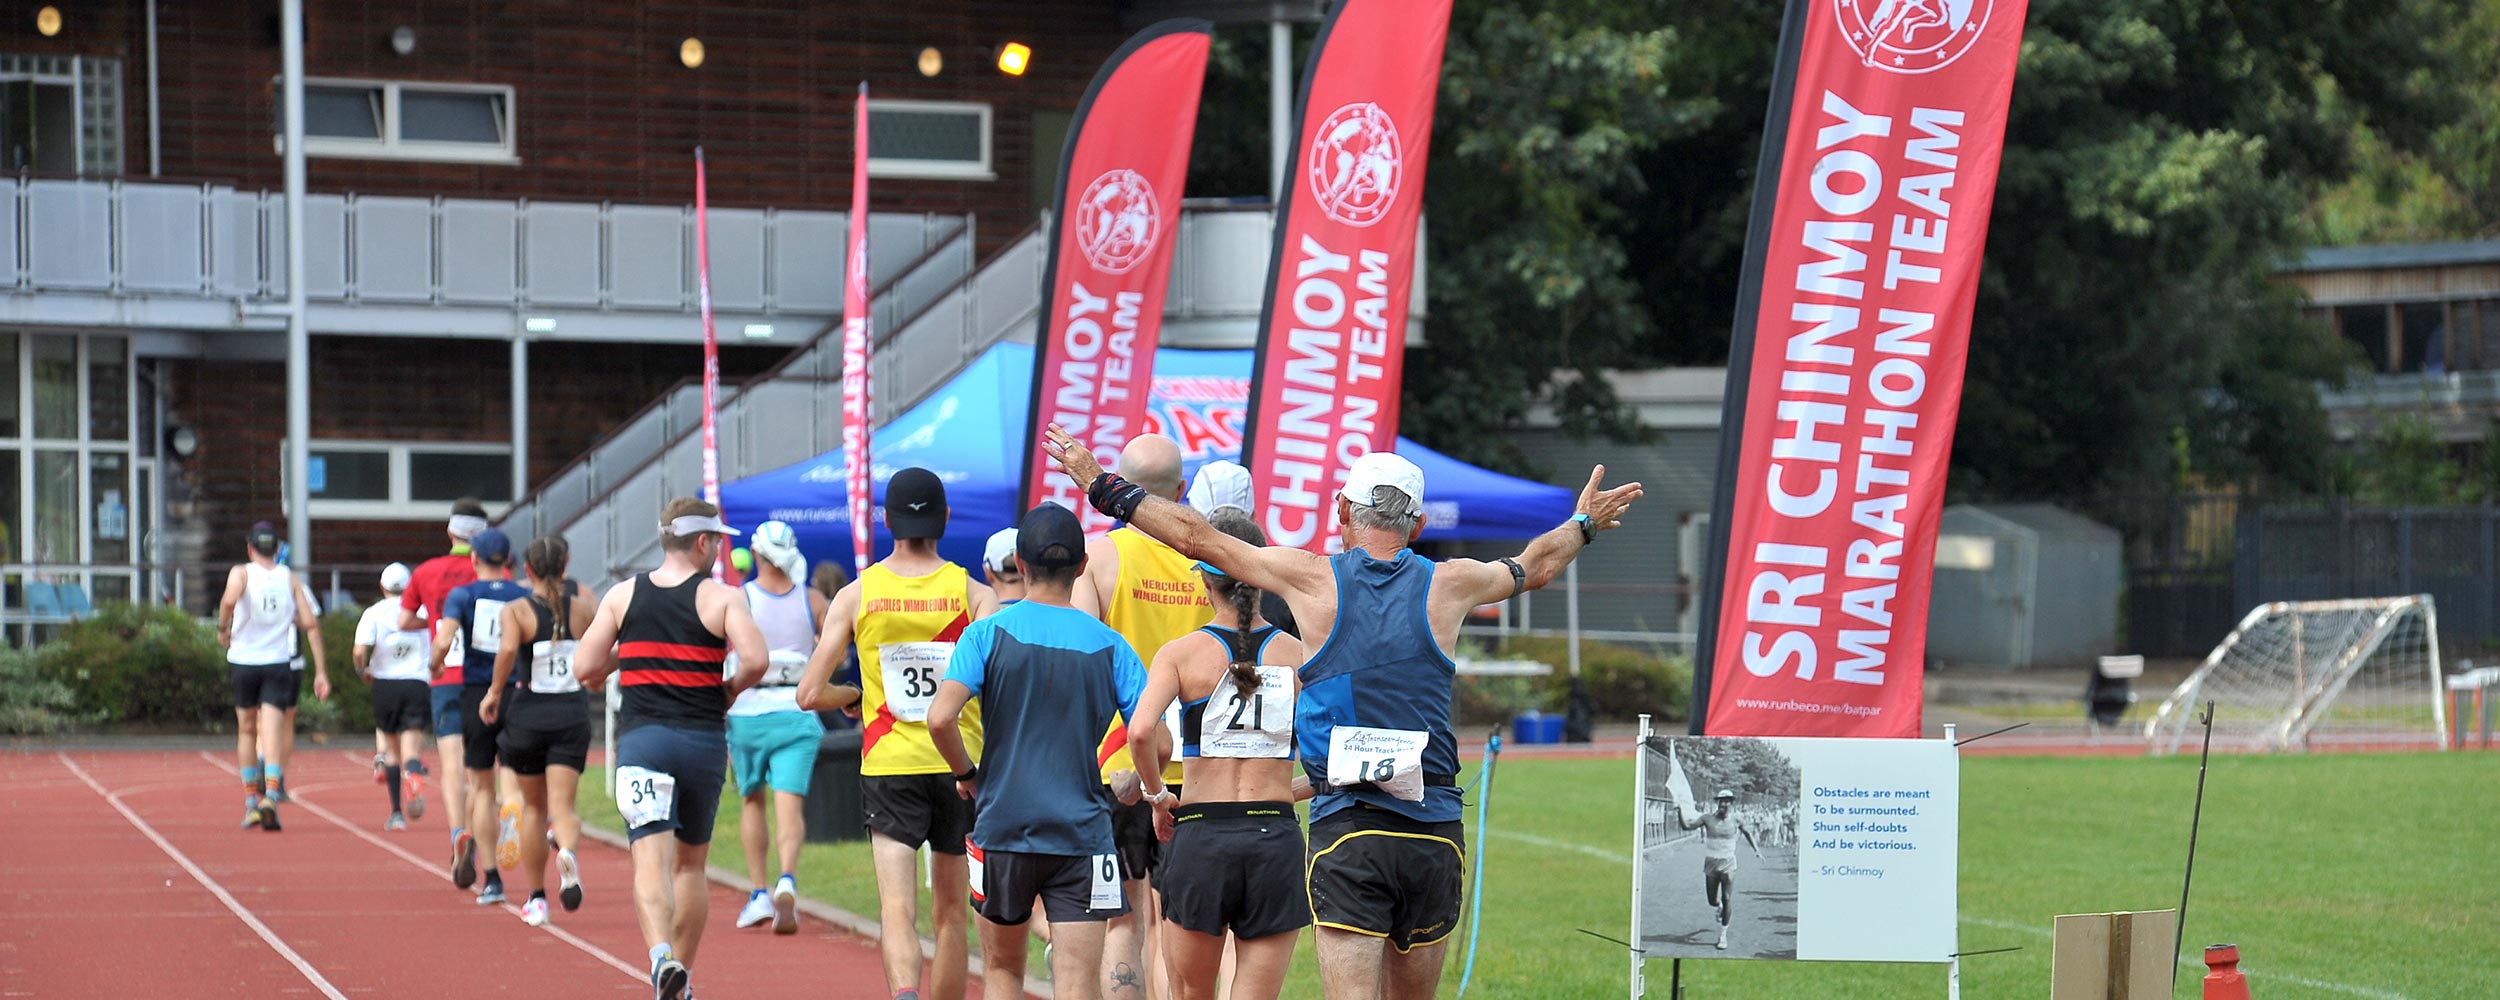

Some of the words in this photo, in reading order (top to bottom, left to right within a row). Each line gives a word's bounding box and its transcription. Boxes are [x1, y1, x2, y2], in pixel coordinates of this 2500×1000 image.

[1883, 106, 1965, 291] TEAM
[1346, 249, 1389, 384] TEAM
[1766, 89, 1893, 518] CHINMOY
[1098, 291, 1144, 406] TEAM
[1266, 233, 1350, 548] CHINMOY
[1833, 308, 1936, 685] MARATHON
[1132, 588, 1192, 606] WIMBLEDON
[1195, 596, 1209, 607] AC
[1142, 579, 1195, 592] HERCULES
[867, 598, 901, 614] HERCULES
[903, 598, 947, 612] WIMBLEDON
[950, 598, 960, 611] AC
[1741, 542, 1828, 681] SRI
[550, 657, 568, 676] 13
[902, 667, 937, 697] 35
[1226, 693, 1262, 731] 21
[1736, 697, 1882, 718] www.runbeco.me/batpar
[1354, 745, 1373, 753] Hour
[1375, 746, 1395, 754] Track
[1359, 757, 1396, 783] 18
[631, 778, 656, 804] 34
[1813, 787, 1869, 798] Obstacles
[1872, 790, 1891, 798] are
[1894, 790, 1931, 799] meant
[1813, 804, 1827, 814] To
[1830, 804, 1845, 815] be
[1848, 805, 1920, 816] surmounted.
[1813, 821, 1841, 832] Shun
[1844, 822, 1908, 833] self-doubts
[1812, 839, 1836, 849] And
[1840, 839, 1854, 849] be
[1858, 839, 1917, 850] victorious.
[1102, 854, 1114, 882] 6
[1821, 865, 1835, 876] Sri
[1838, 865, 1884, 879] Chinmoy
